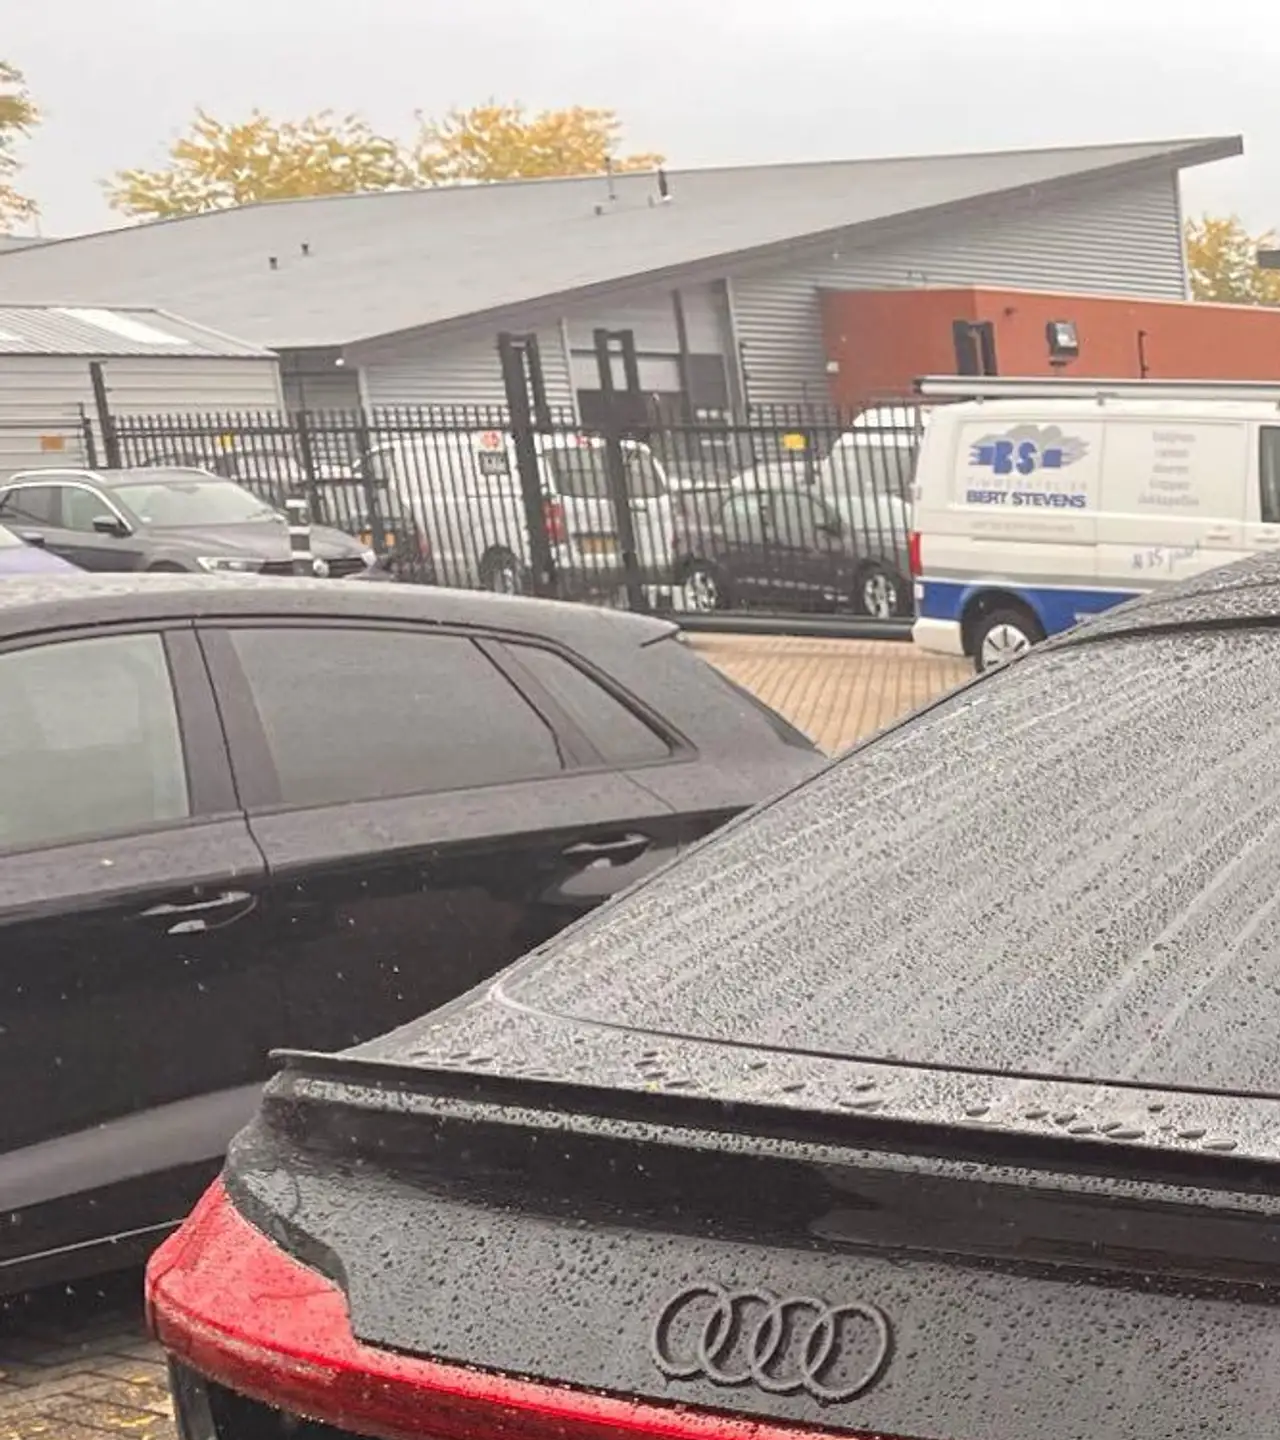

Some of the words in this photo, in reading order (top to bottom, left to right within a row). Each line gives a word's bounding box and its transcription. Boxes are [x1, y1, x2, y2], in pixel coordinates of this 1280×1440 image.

[993, 440, 1038, 476] BS
[966, 490, 1008, 504] BERT
[1011, 492, 1087, 508] STEVENS
